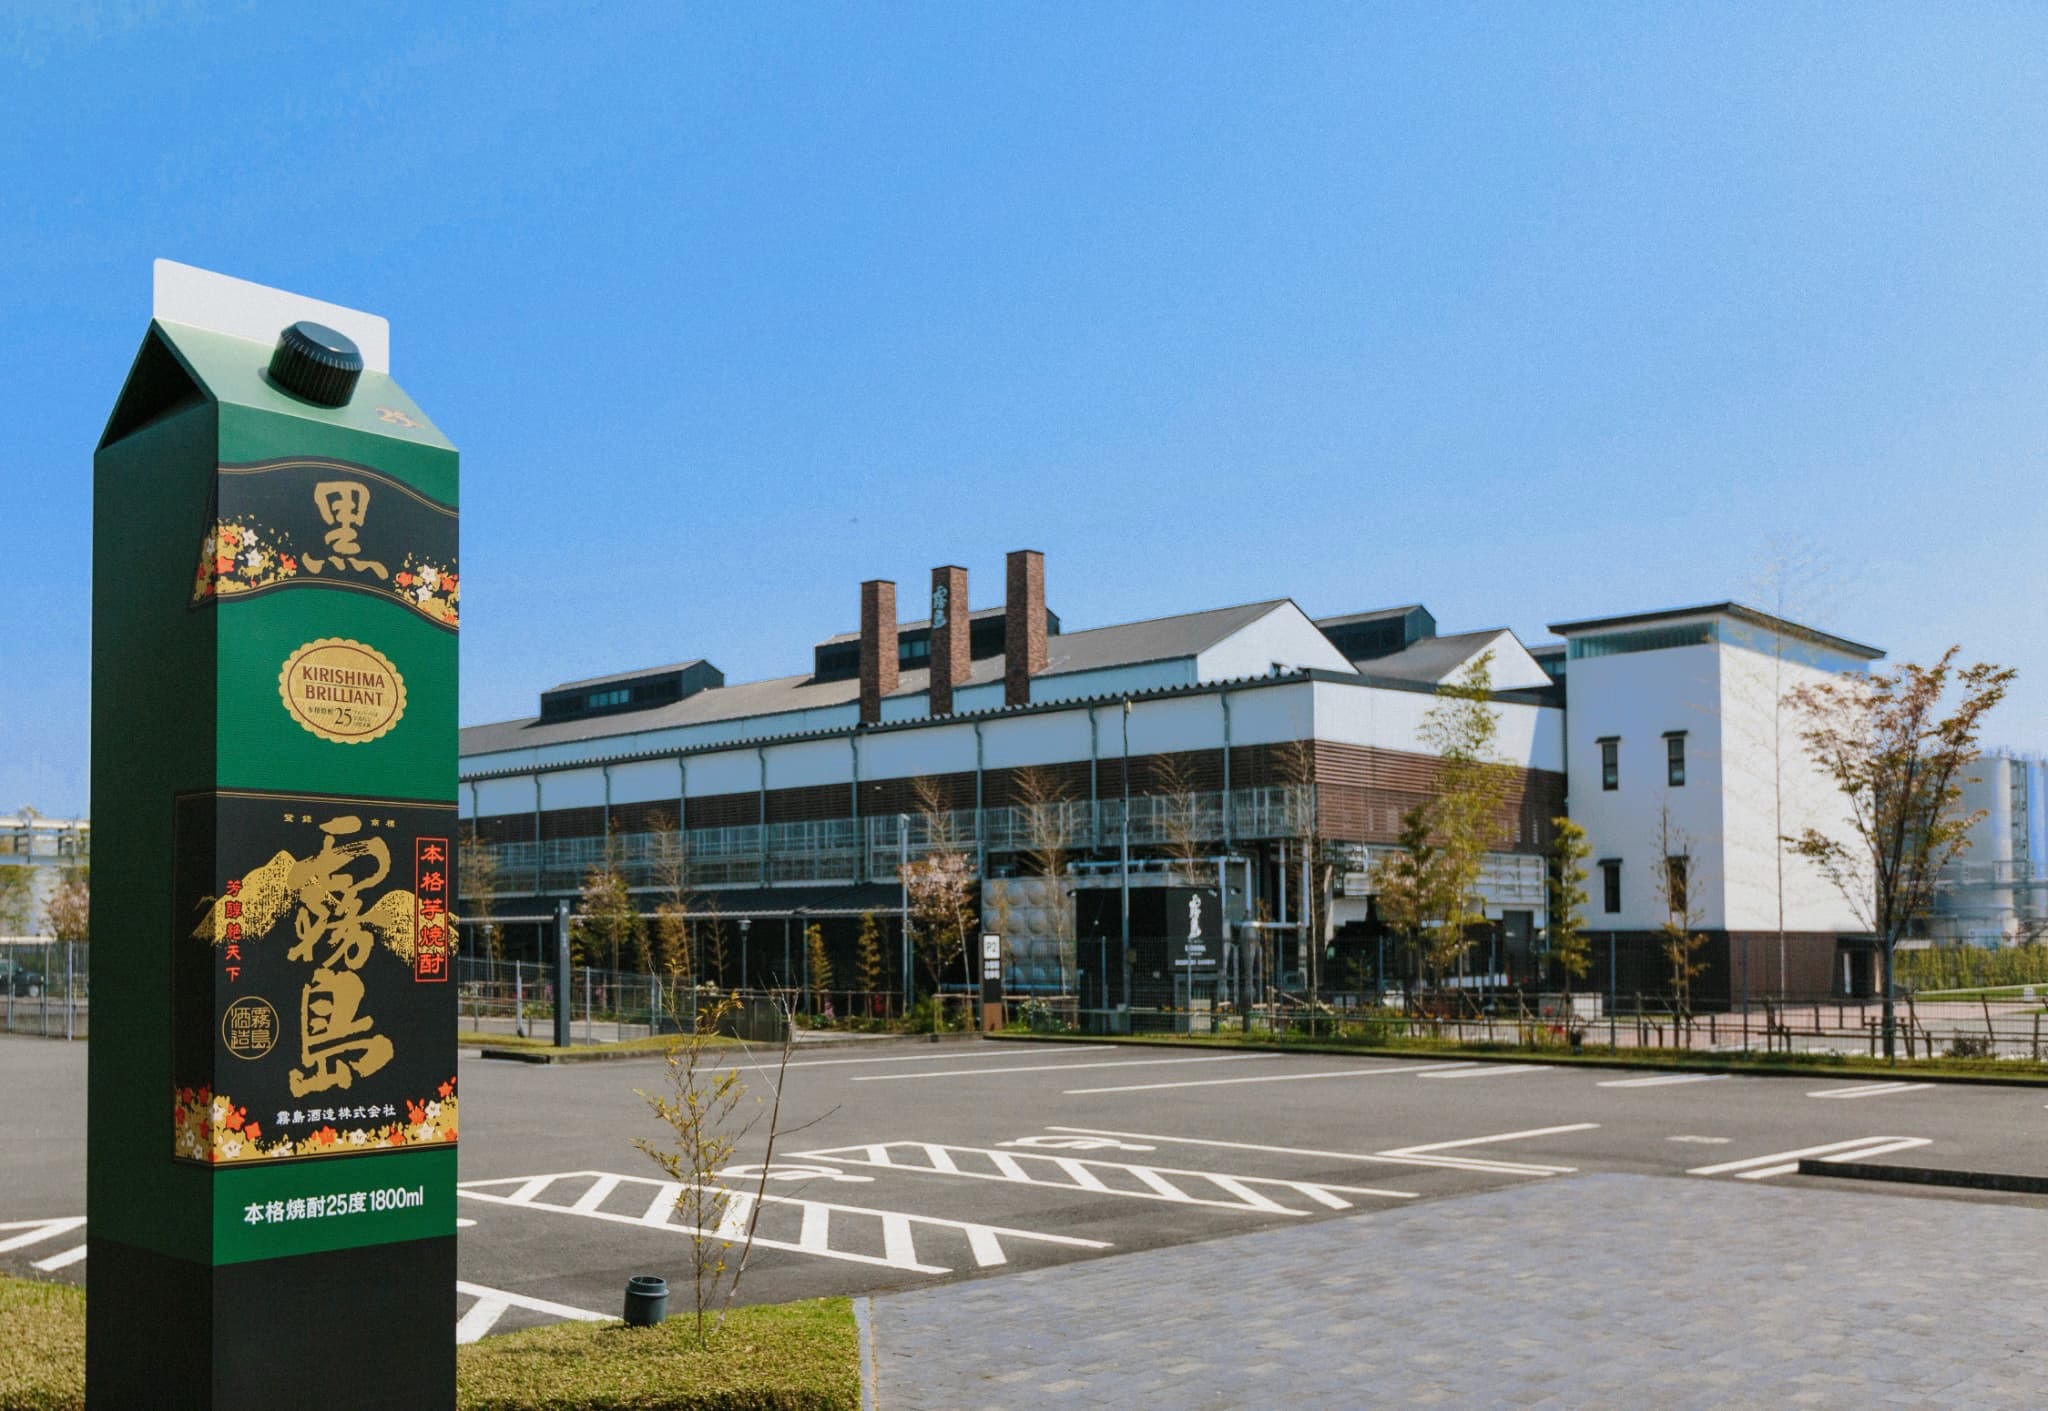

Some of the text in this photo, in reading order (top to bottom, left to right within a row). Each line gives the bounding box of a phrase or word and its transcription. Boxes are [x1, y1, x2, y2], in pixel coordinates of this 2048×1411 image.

[301, 480, 390, 581] 黒
[302, 665, 386, 689] KIRISHIMA
[304, 684, 384, 707] BRILLIANT
[334, 706, 353, 727] 25
[419, 843, 445, 975] 本格芋焼酎
[275, 1103, 397, 1126] 霧島酒造株式会社
[243, 1184, 424, 1226] 本格焼酎25度 1800ml
